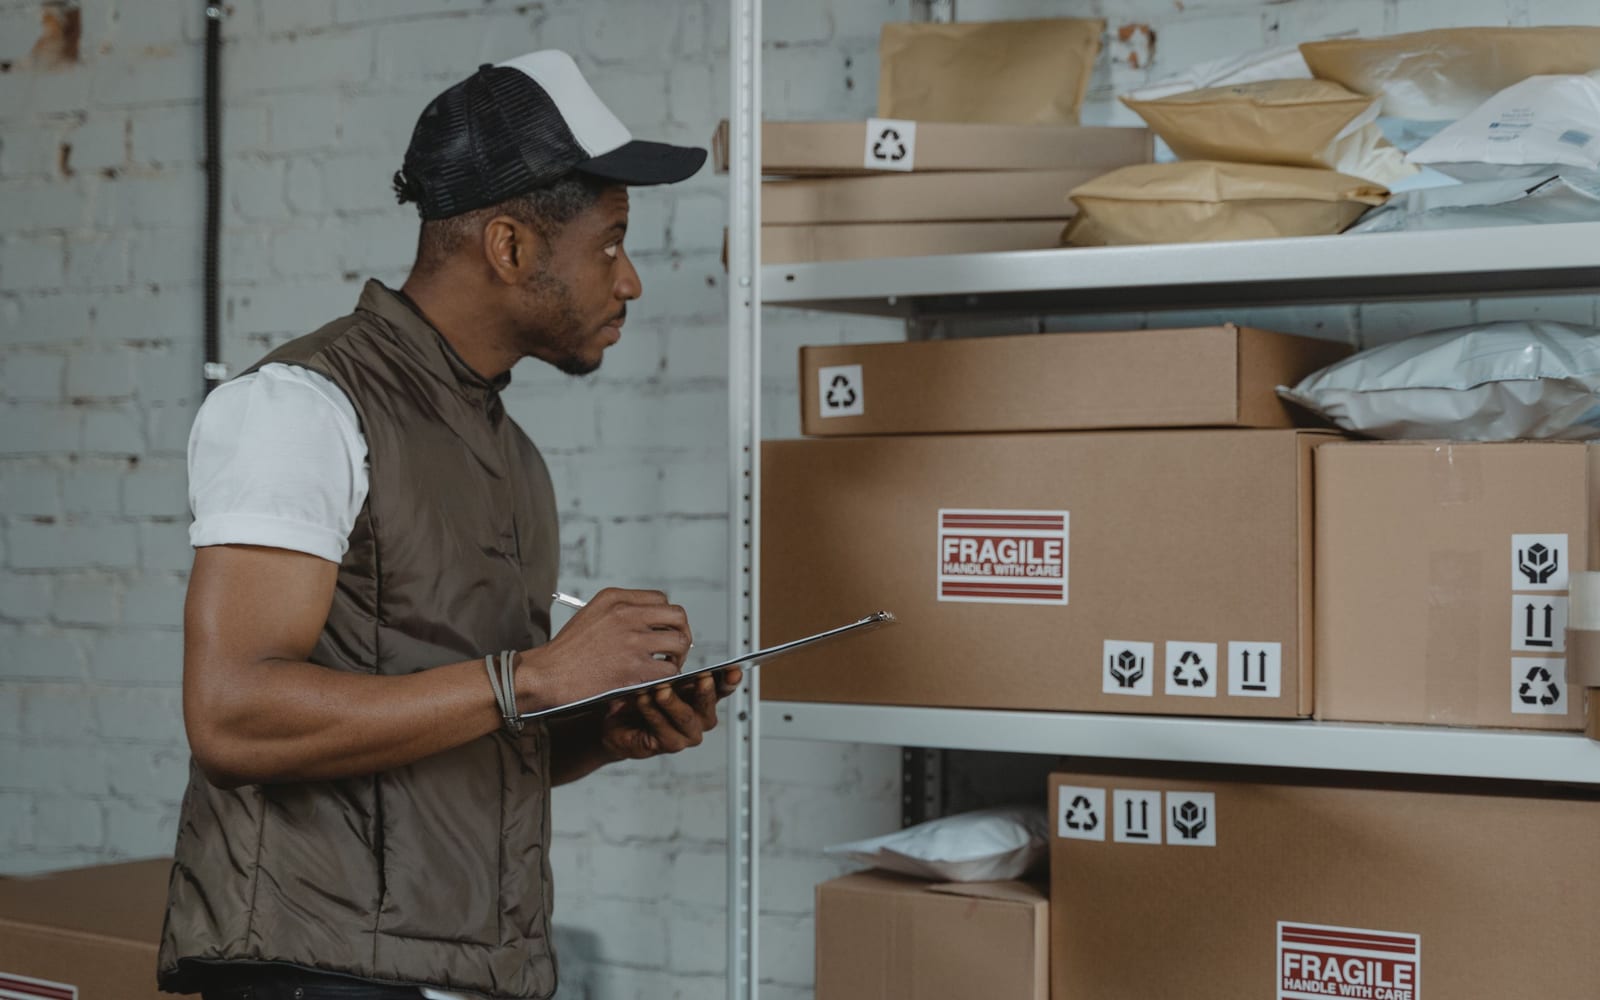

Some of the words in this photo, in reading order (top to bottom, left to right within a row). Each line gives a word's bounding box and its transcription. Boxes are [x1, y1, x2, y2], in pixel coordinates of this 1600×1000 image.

[944, 538, 1061, 565] FRAGILE
[944, 563, 992, 575] HANDLE
[994, 564, 1024, 576] WITH
[1026, 565, 1061, 577] CARE
[1284, 952, 1412, 990] FRAGILE
[1284, 978, 1336, 994] HANDLE
[1339, 984, 1372, 998] WITH
[1375, 988, 1412, 1000] CARE
